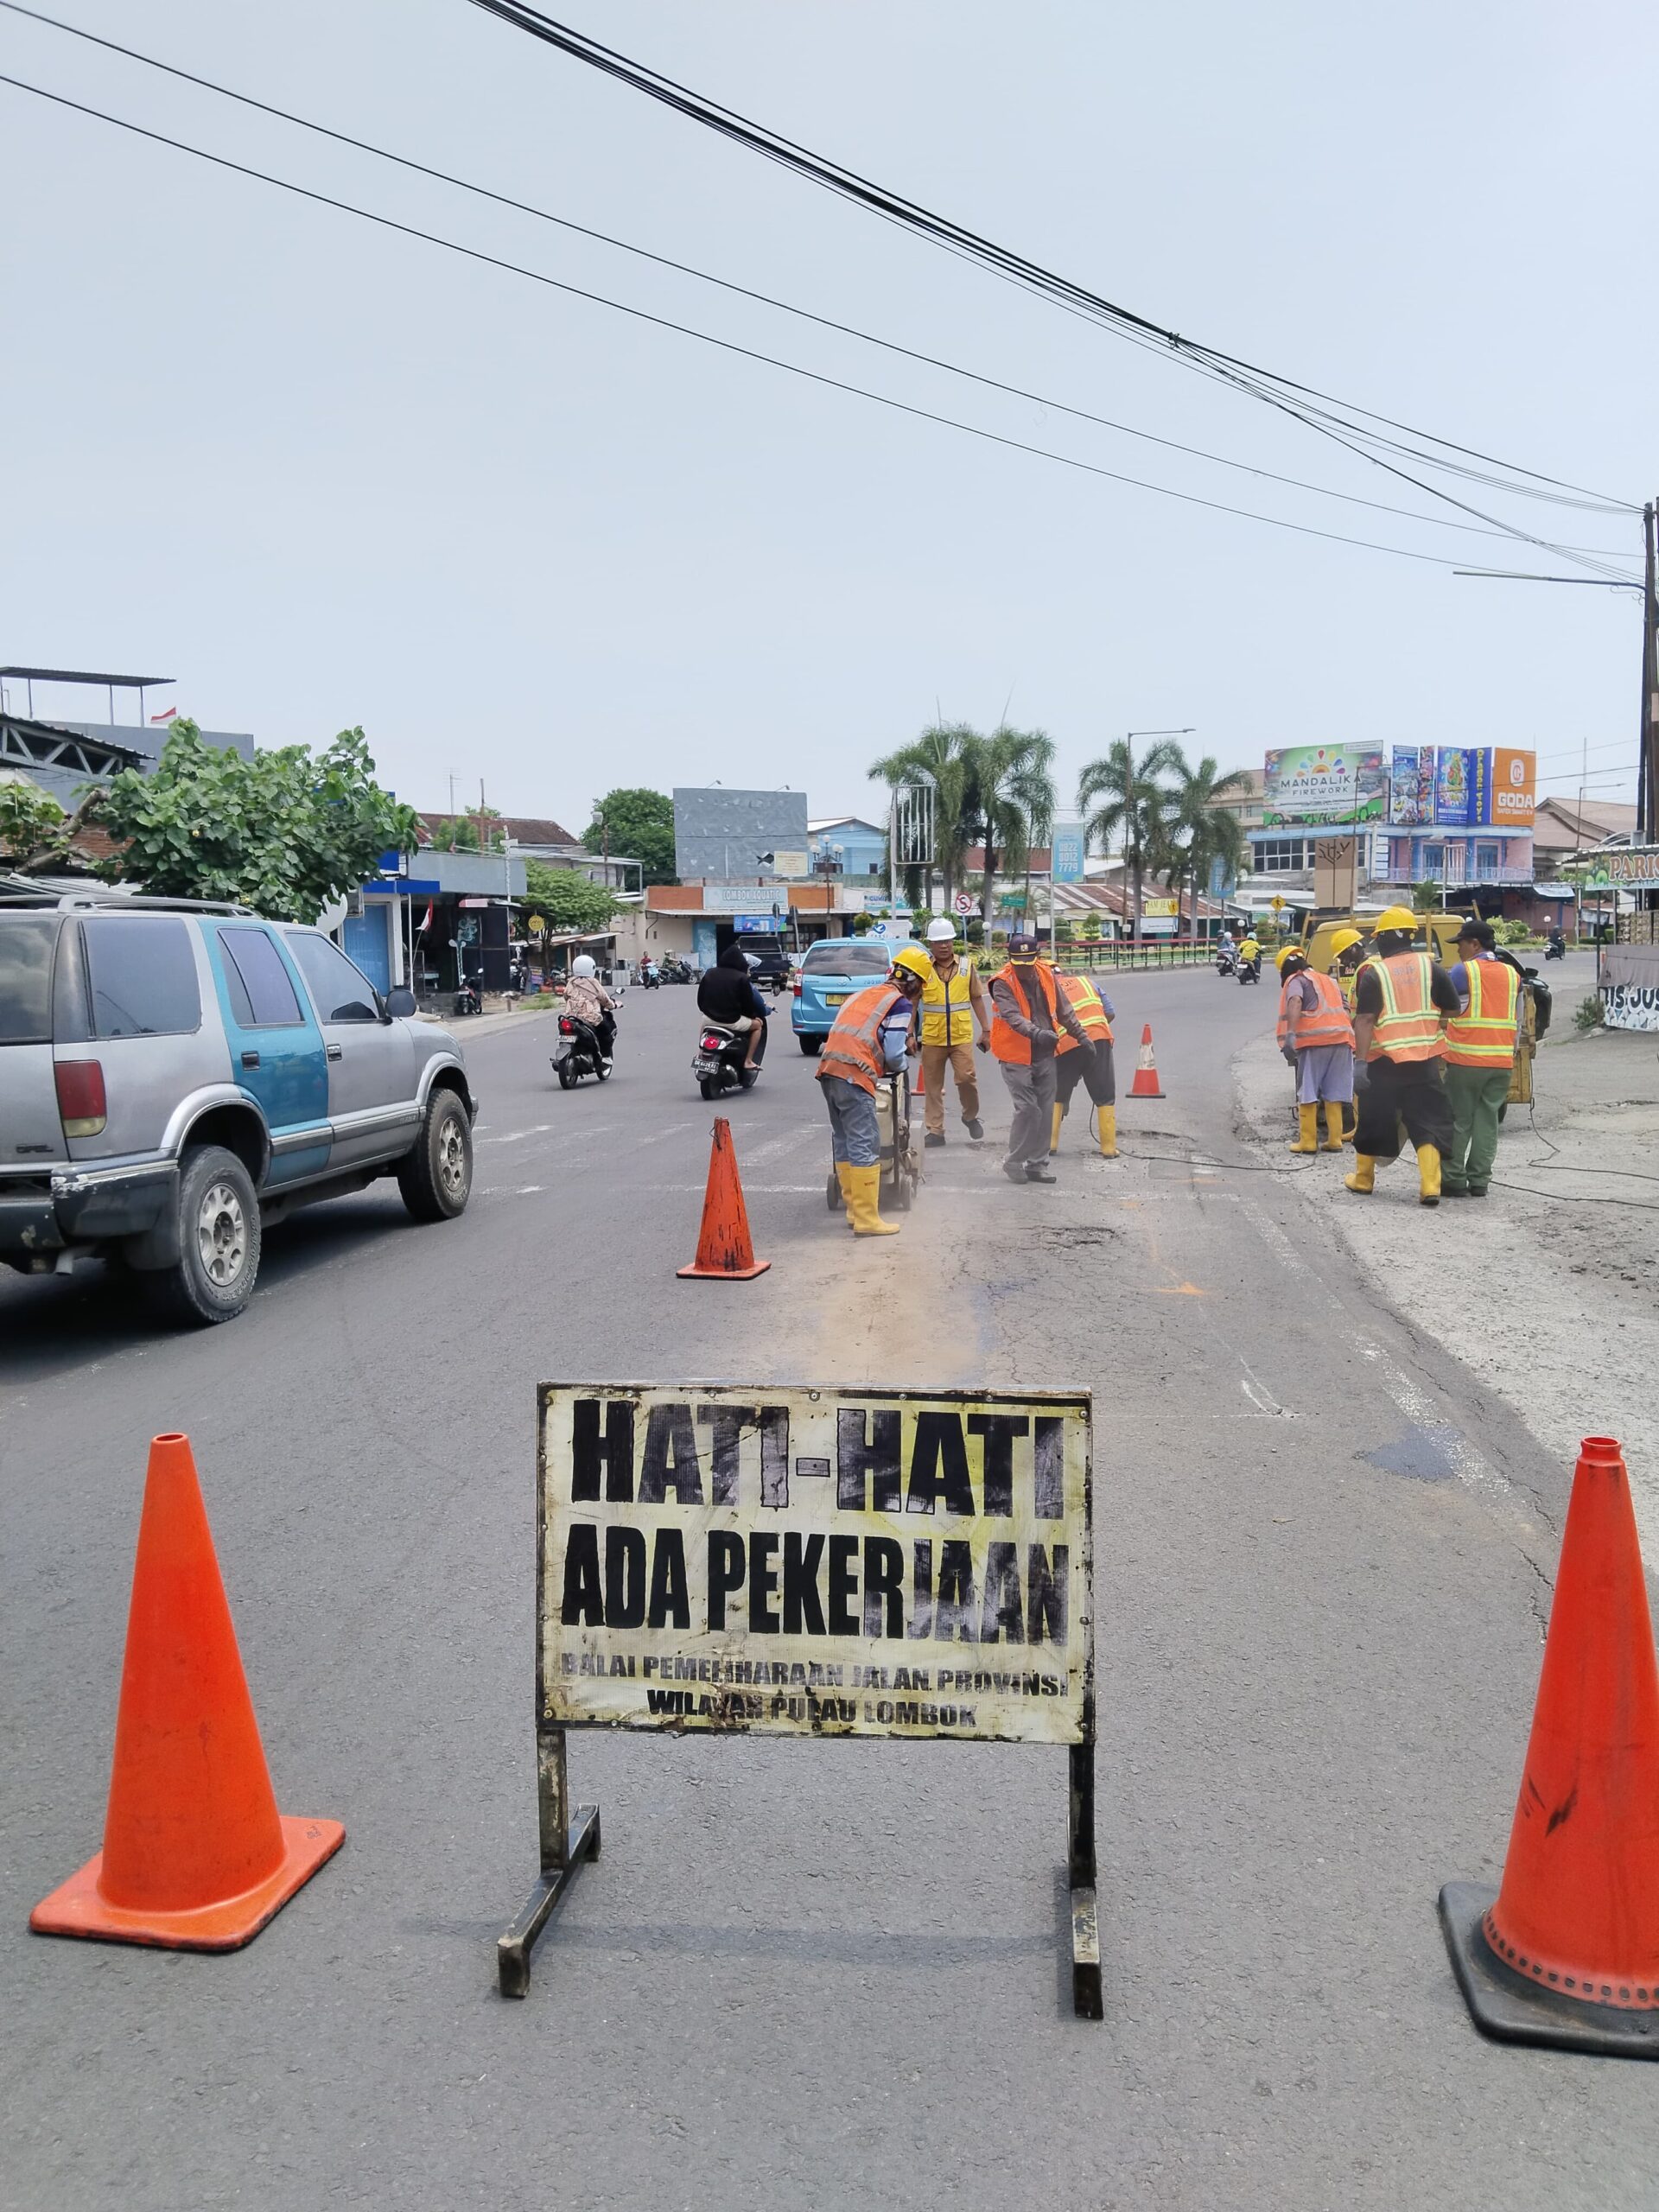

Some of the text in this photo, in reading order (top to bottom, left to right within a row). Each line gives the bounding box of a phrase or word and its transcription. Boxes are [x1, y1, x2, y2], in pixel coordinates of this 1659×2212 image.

[1281, 775, 1362, 789] MANDALIKA
[1292, 786, 1349, 797] FIREWORK
[1497, 791, 1534, 809] GODA
[571, 1398, 1065, 1520] HATI-HATI
[561, 1523, 1069, 1646] ADA PEKERJAAN
[561, 1652, 636, 1678] BALAI
[643, 1656, 843, 1688] PEMELIHARAAN
[938, 1669, 1069, 1697] PROVINSI
[771, 1696, 856, 1723] PULAU
[865, 1700, 977, 1727] LOMBOK
